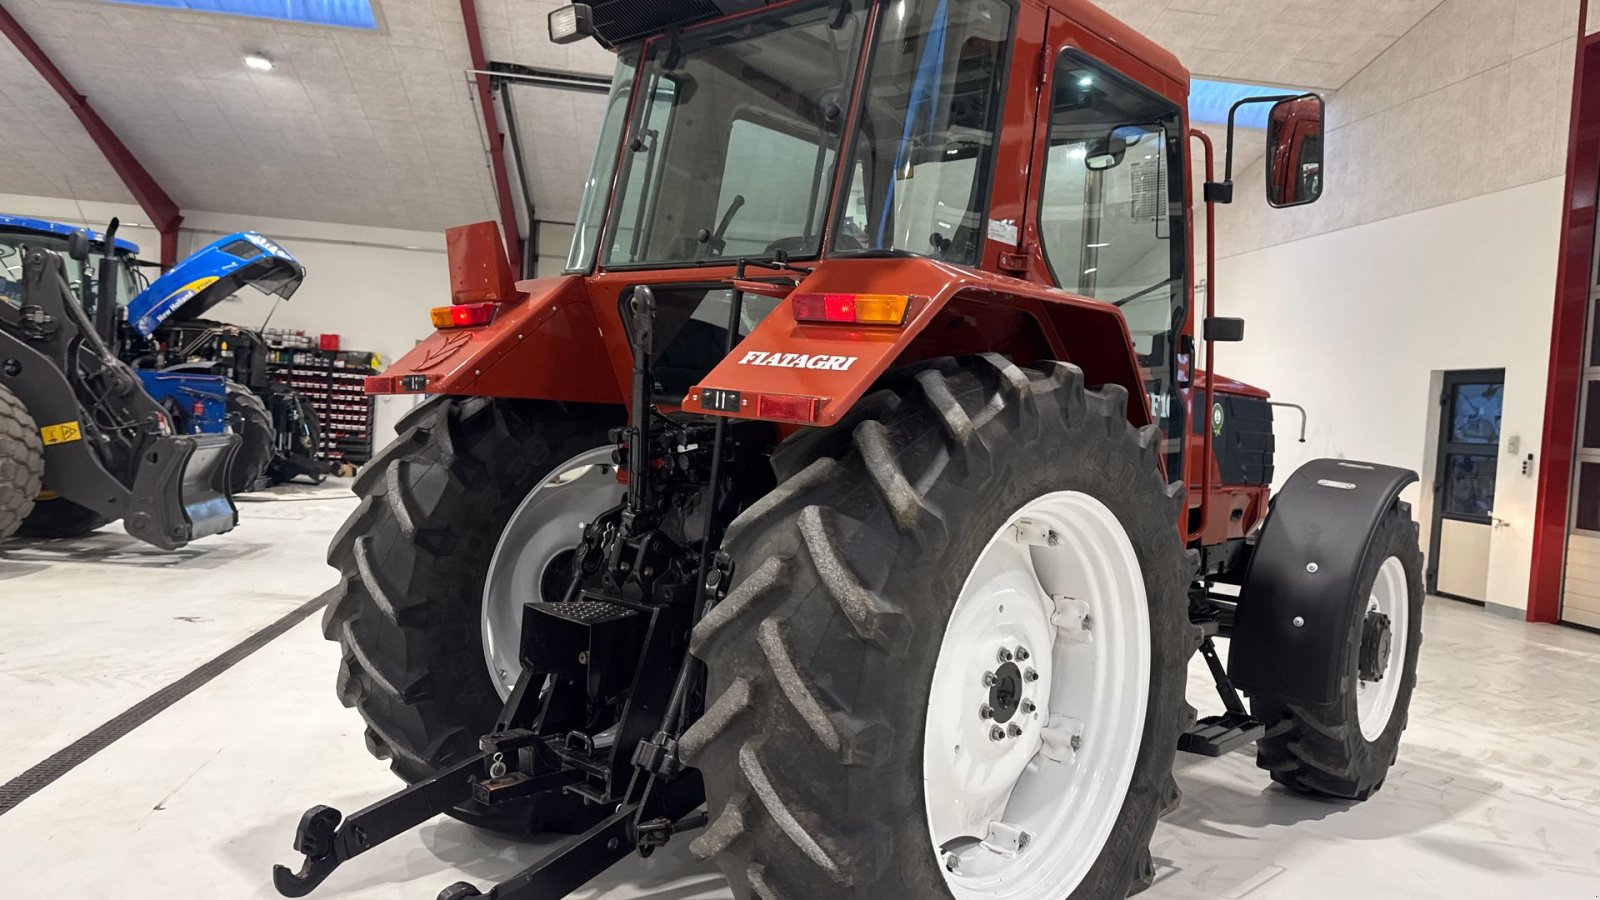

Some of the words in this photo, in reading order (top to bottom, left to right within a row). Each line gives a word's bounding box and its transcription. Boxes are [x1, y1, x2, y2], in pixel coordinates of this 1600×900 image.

[156, 309, 171, 322] New
[169, 290, 195, 311] Holland
[738, 351, 858, 371] FIATAGRI
